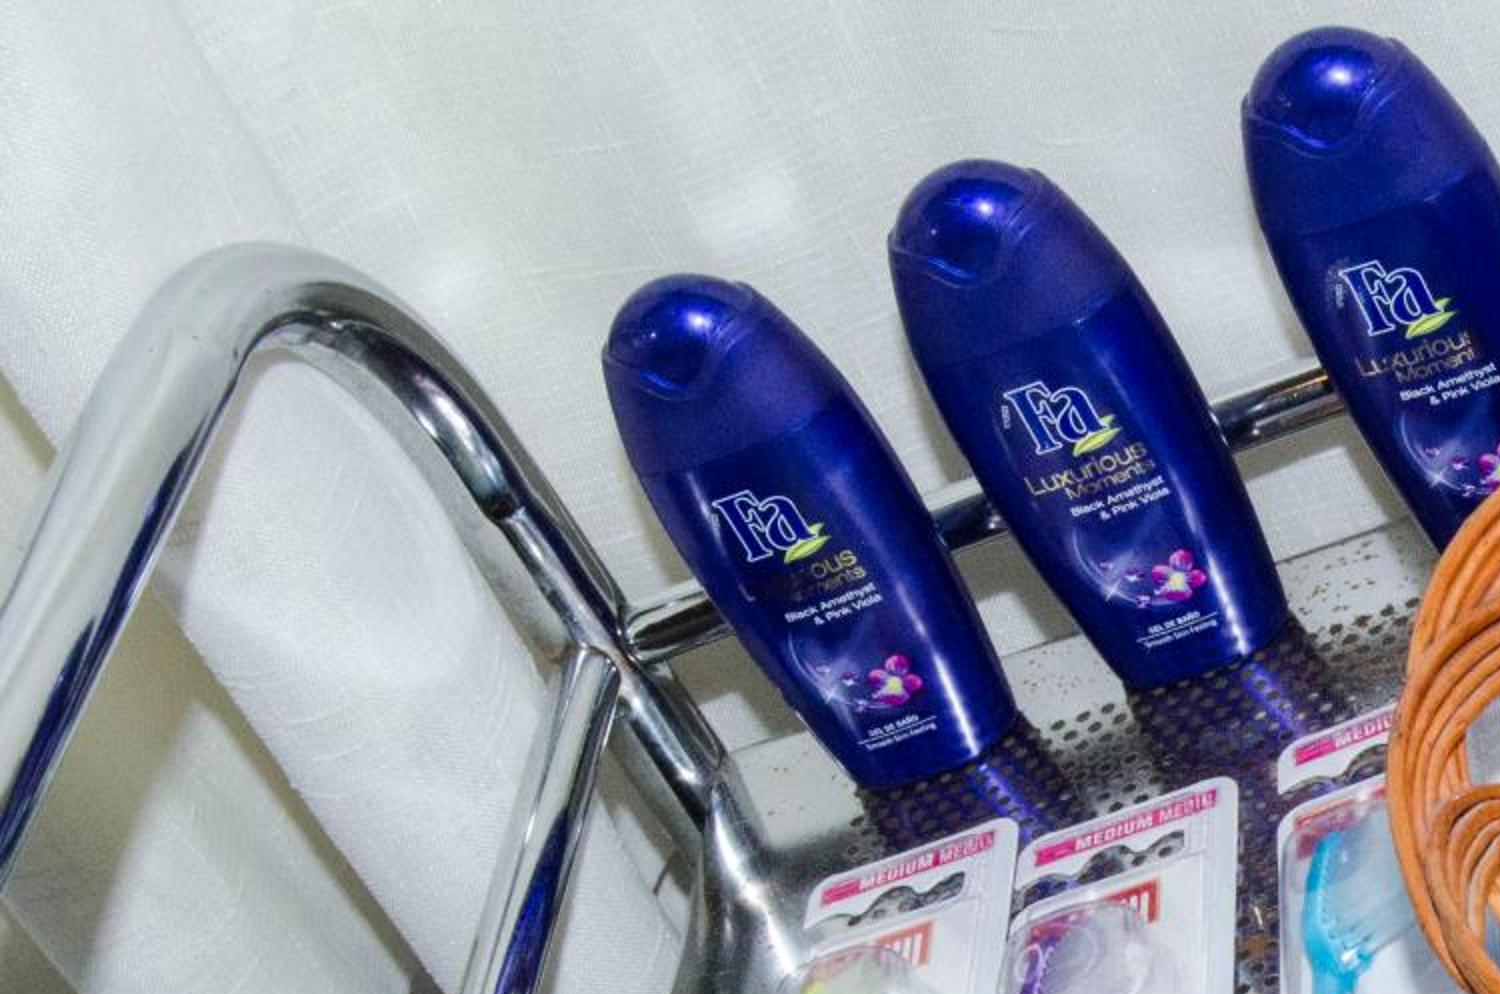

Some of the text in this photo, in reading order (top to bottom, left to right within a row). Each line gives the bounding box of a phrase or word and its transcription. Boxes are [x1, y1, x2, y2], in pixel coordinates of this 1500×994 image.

[1338, 260, 1446, 336] Fa
[1400, 362, 1497, 401] Black Amethyst
[1442, 386, 1469, 401] Pink
[1003, 381, 1109, 455] Fa
[1024, 442, 1147, 496] Luxurious
[1070, 475, 1165, 517] Black Amethyst
[1111, 500, 1139, 515] Pink
[712, 489, 817, 562] Fa
[784, 582, 876, 623] Black Amethyst
[825, 607, 852, 621] Pink
[1074, 813, 1153, 850] MEDIUM
[858, 856, 934, 890] MEDIUM
